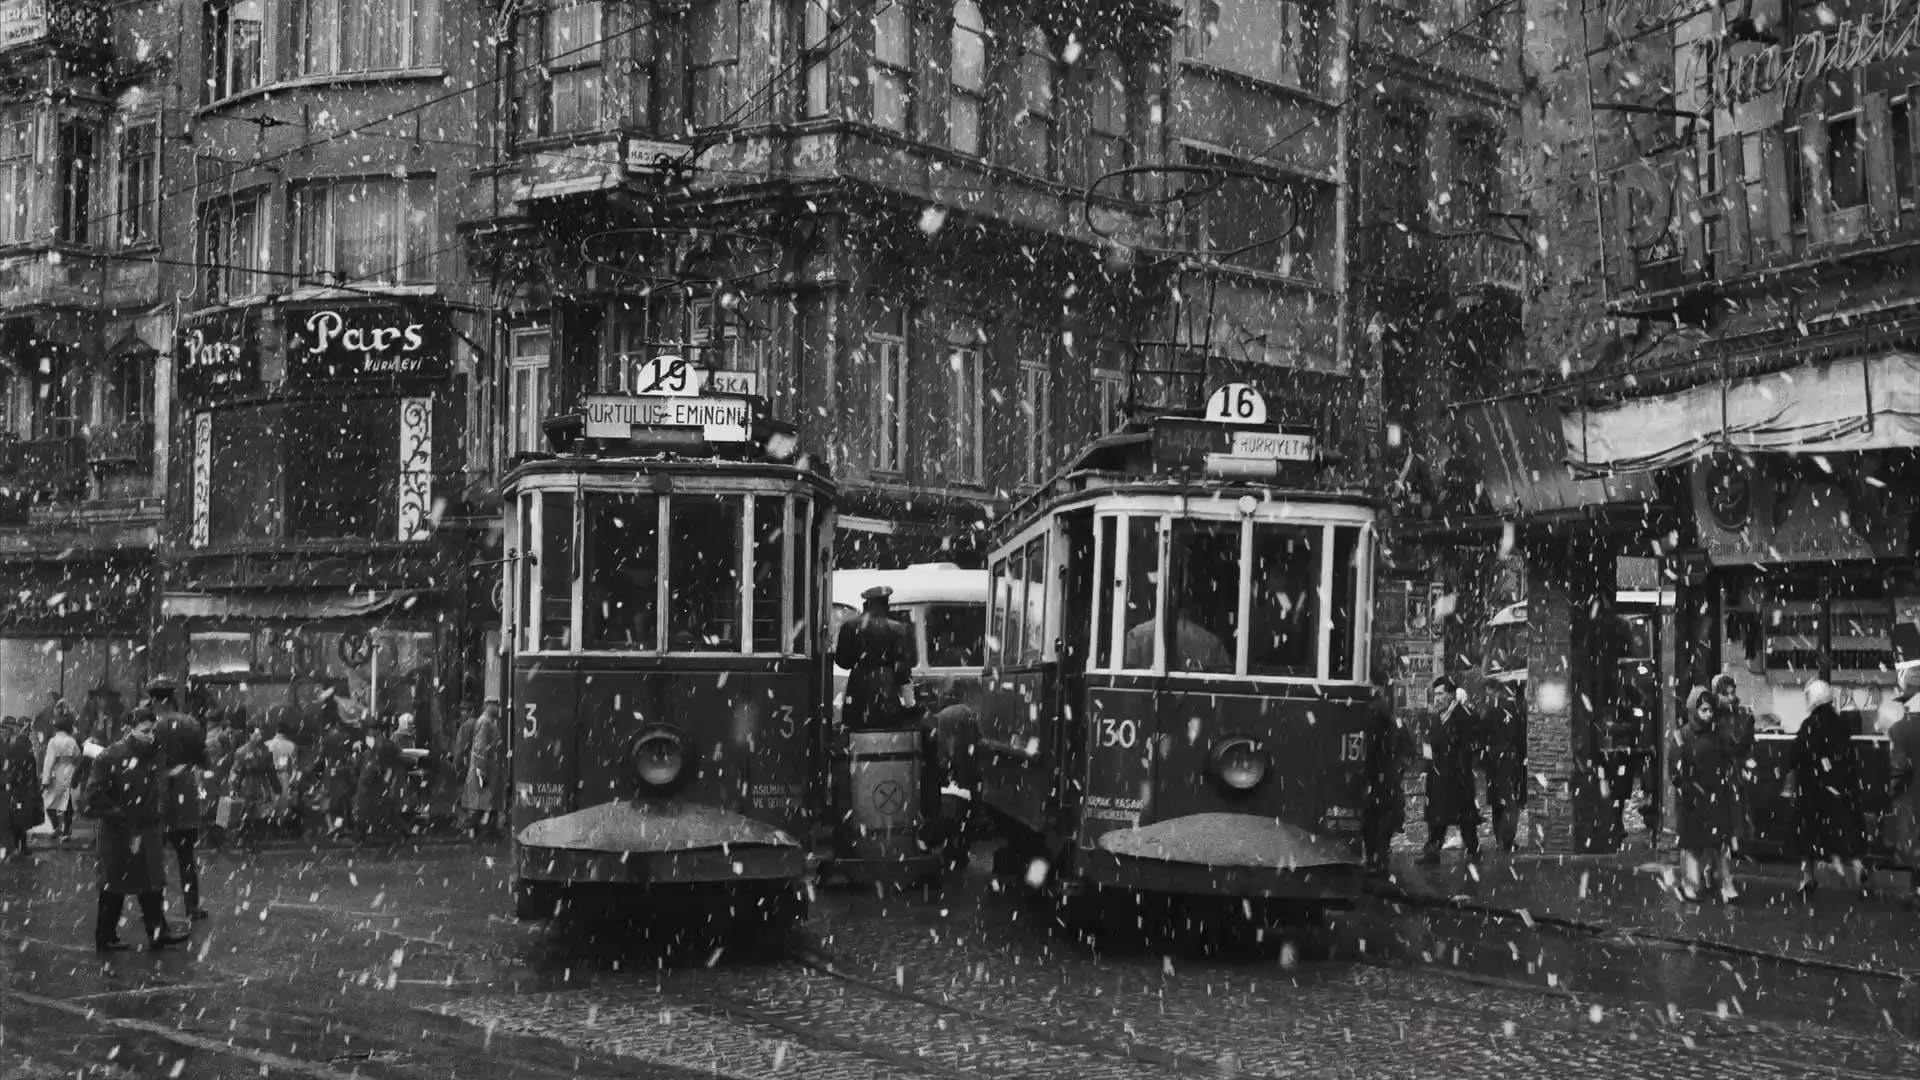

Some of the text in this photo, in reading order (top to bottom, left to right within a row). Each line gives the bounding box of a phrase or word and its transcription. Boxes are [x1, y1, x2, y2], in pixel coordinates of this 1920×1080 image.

[306, 311, 424, 353] Pars
[647, 359, 687, 392] 19
[1220, 386, 1254, 418] 16
[524, 703, 537, 738] 3
[780, 705, 794, 738] 3
[1096, 718, 1136, 749] 130
[536, 783, 565, 793] YASAK
